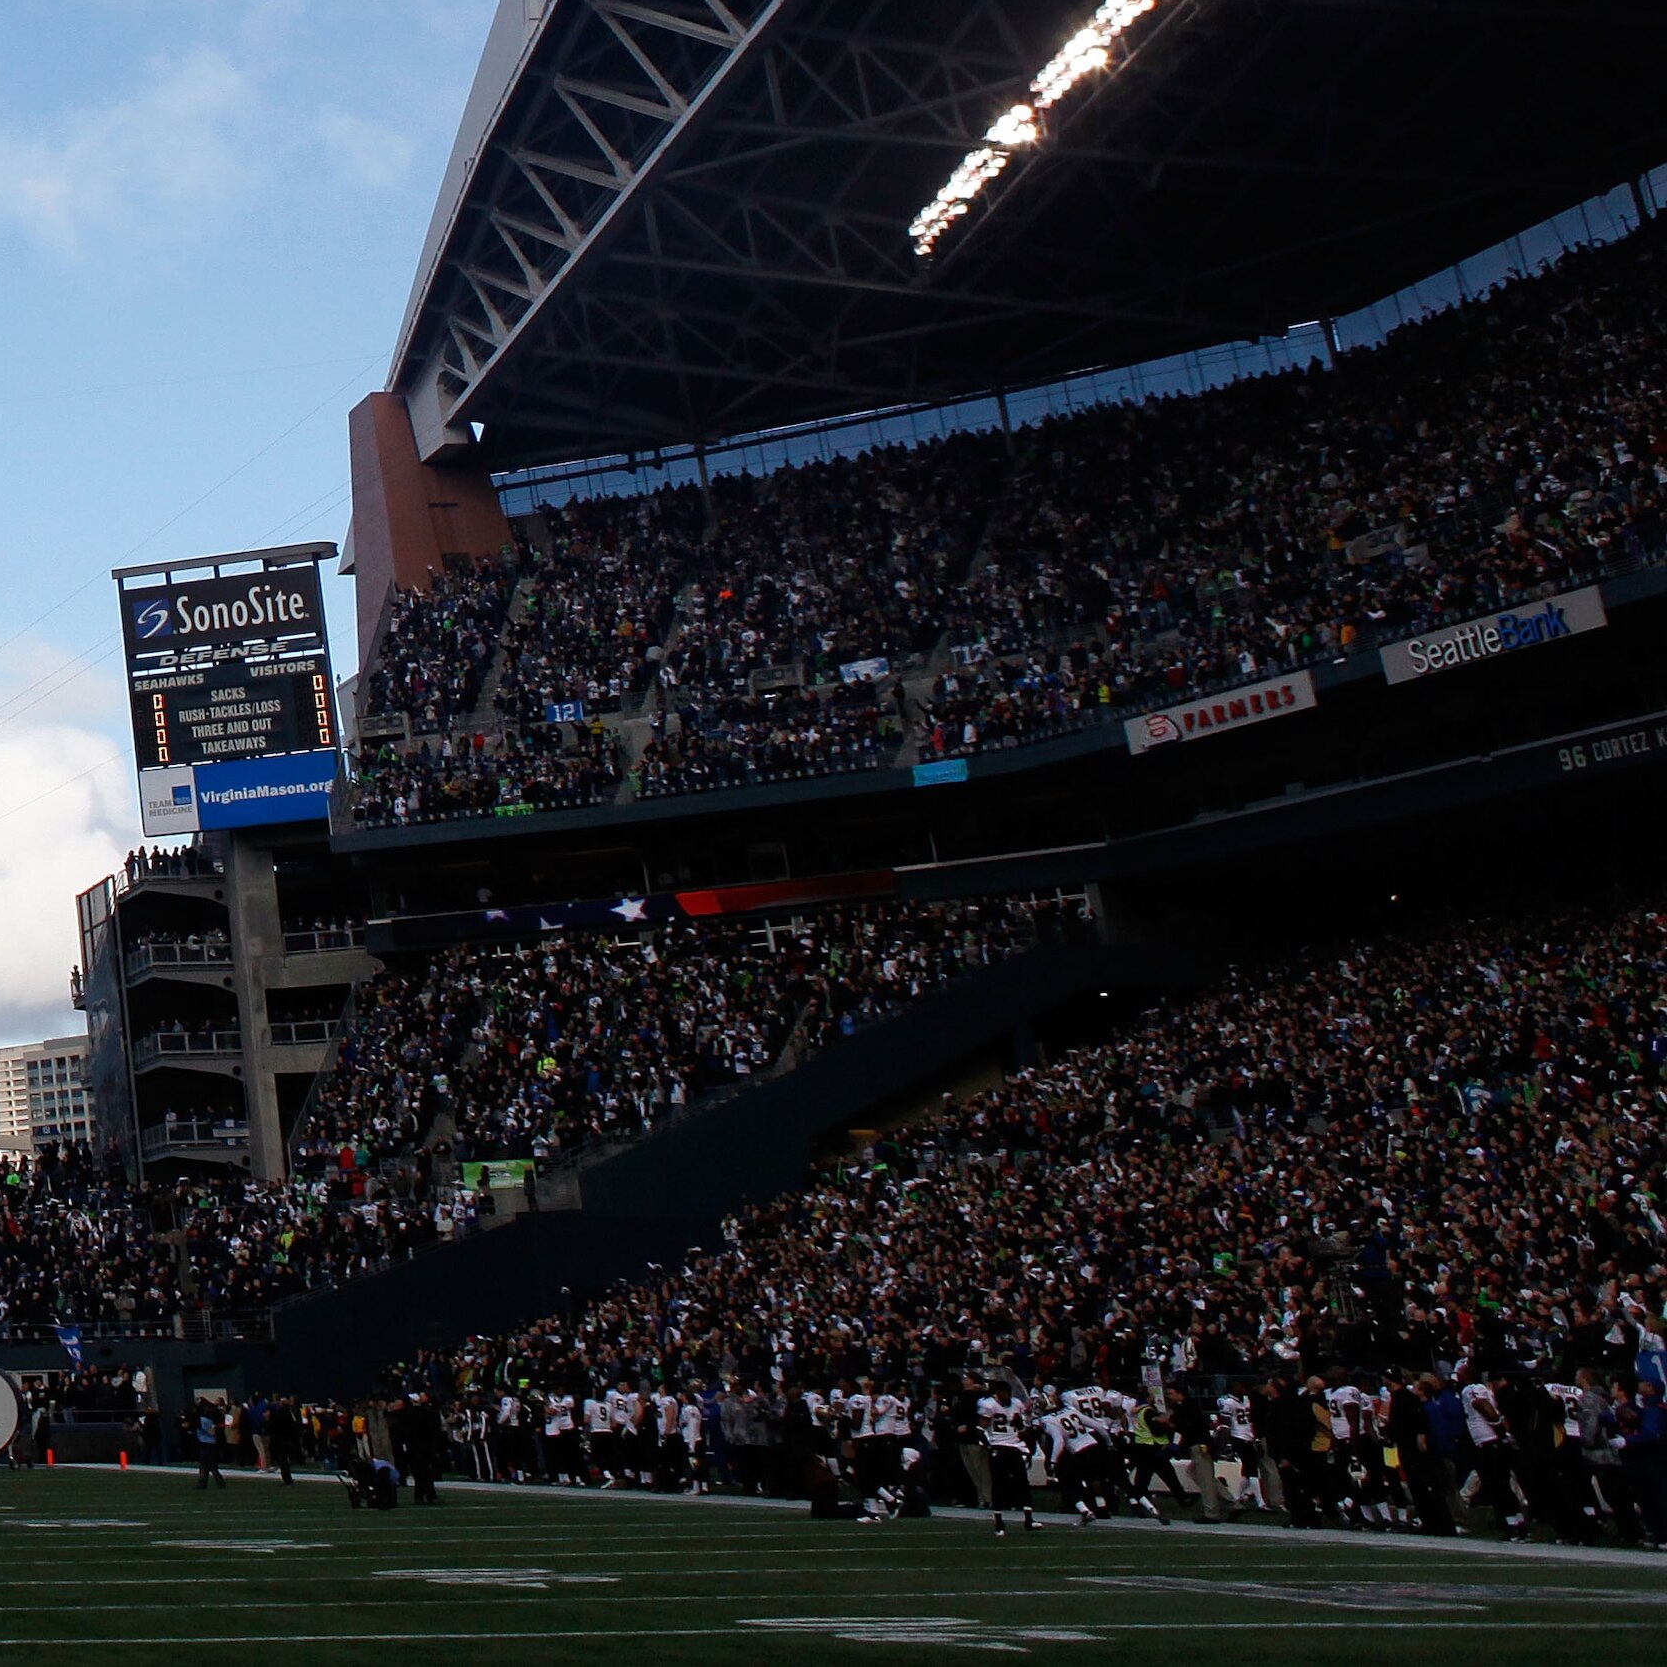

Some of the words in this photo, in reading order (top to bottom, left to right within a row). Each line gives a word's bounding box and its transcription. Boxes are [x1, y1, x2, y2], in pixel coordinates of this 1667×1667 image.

[177, 584, 306, 634] SonoSite
[1408, 602, 1572, 674] SeattleBank
[159, 641, 288, 666] DEFENSE
[134, 672, 204, 691] SEAHAWKS
[249, 659, 316, 677] VISITORS
[312, 675, 323, 691] 0
[153, 694, 163, 710] 0
[211, 687, 246, 702] SACKS
[315, 692, 326, 708] 0
[553, 703, 575, 723] 12
[1183, 685, 1295, 732] FARMERS
[155, 711, 166, 727] 0
[317, 710, 328, 726] 0
[156, 729, 167, 744] 0
[191, 723, 225, 738] THREE
[227, 721, 249, 735] AND
[252, 718, 272, 732] OUT
[319, 728, 330, 745] 0
[158, 746, 169, 762] 0
[200, 735, 267, 755] TAKEAWAYS
[1558, 745, 1588, 772] 96
[1591, 732, 1650, 763] CORTEZ
[201, 780, 333, 805] VirginiaMason.org
[148, 800, 172, 809] TEAM
[149, 806, 193, 817] MEDICINE
[1060, 1414, 1086, 1439] 93
